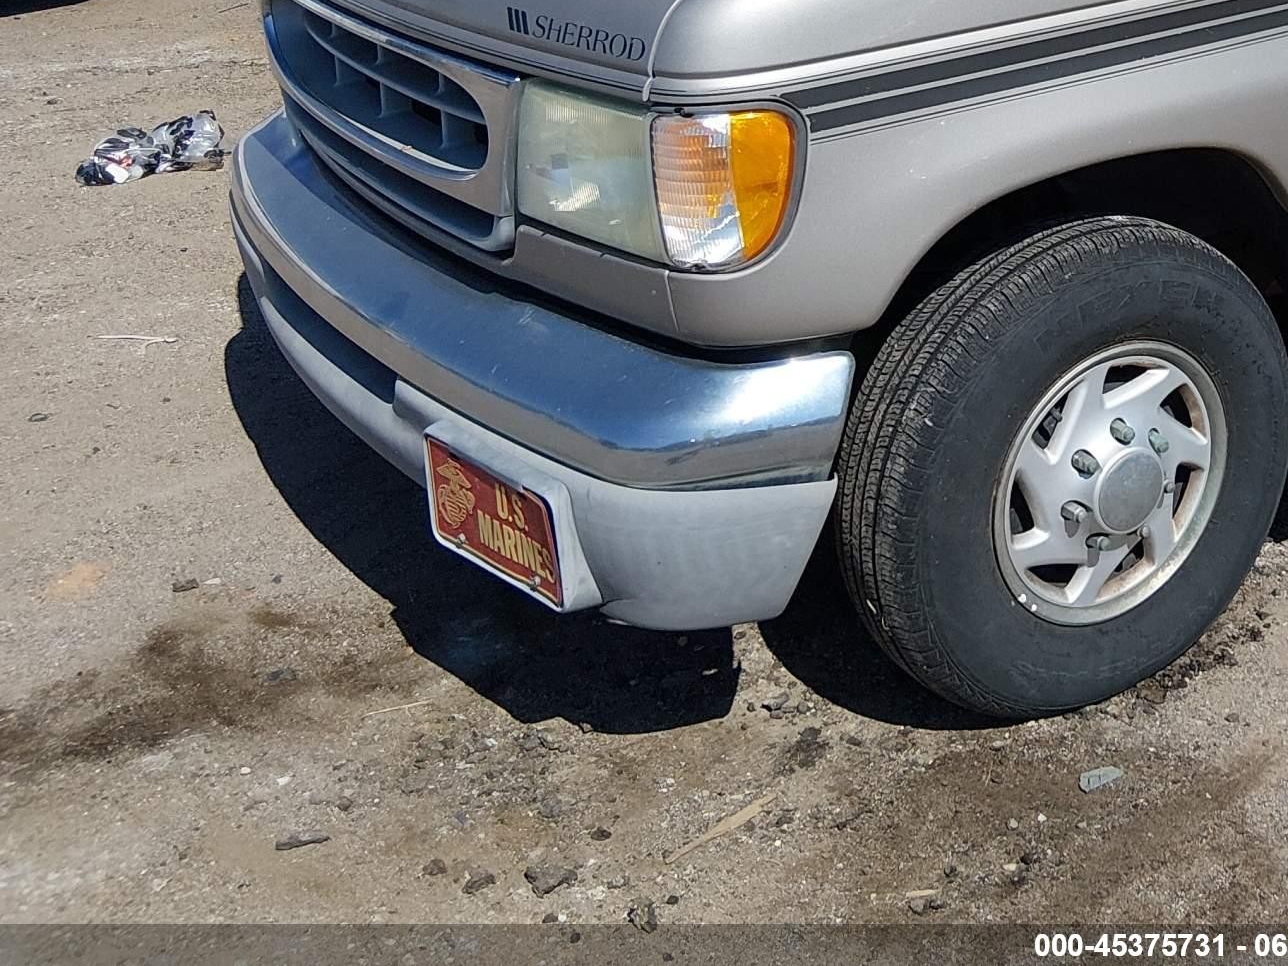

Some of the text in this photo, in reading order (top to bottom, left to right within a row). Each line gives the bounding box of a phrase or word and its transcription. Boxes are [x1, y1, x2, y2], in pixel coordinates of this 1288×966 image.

[533, 15, 646, 61] SHERROD
[495, 482, 529, 531] U.S.
[477, 509, 555, 583] MARINES
